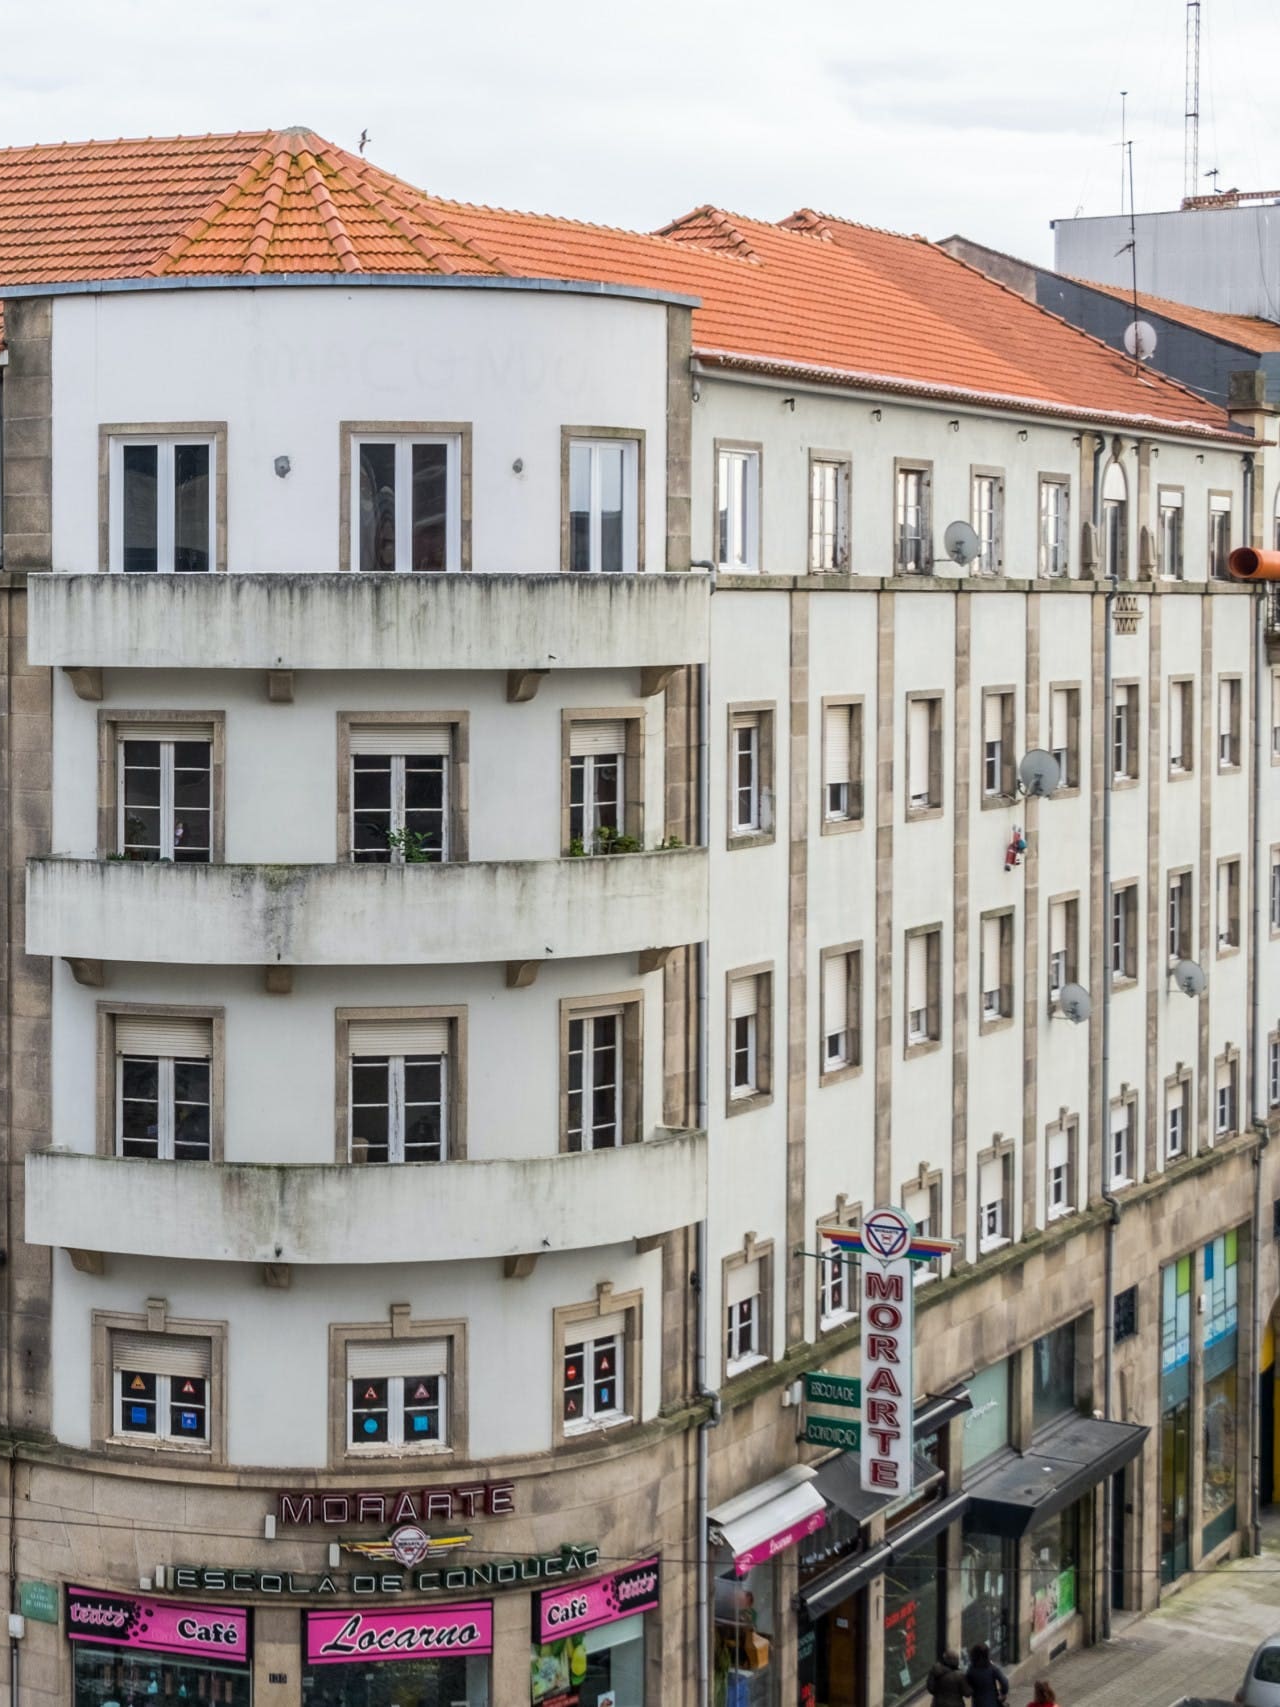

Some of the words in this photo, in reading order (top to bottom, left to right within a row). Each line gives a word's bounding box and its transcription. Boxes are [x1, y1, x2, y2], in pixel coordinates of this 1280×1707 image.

[865, 1271, 902, 1489] MORARTE
[280, 1483, 516, 1524] MORARTE
[176, 1568, 337, 1593] ESCOLA
[352, 1573, 404, 1593] DE
[546, 1593, 588, 1627] Café
[176, 1618, 239, 1645] Café
[320, 1612, 481, 1654] Locarno
